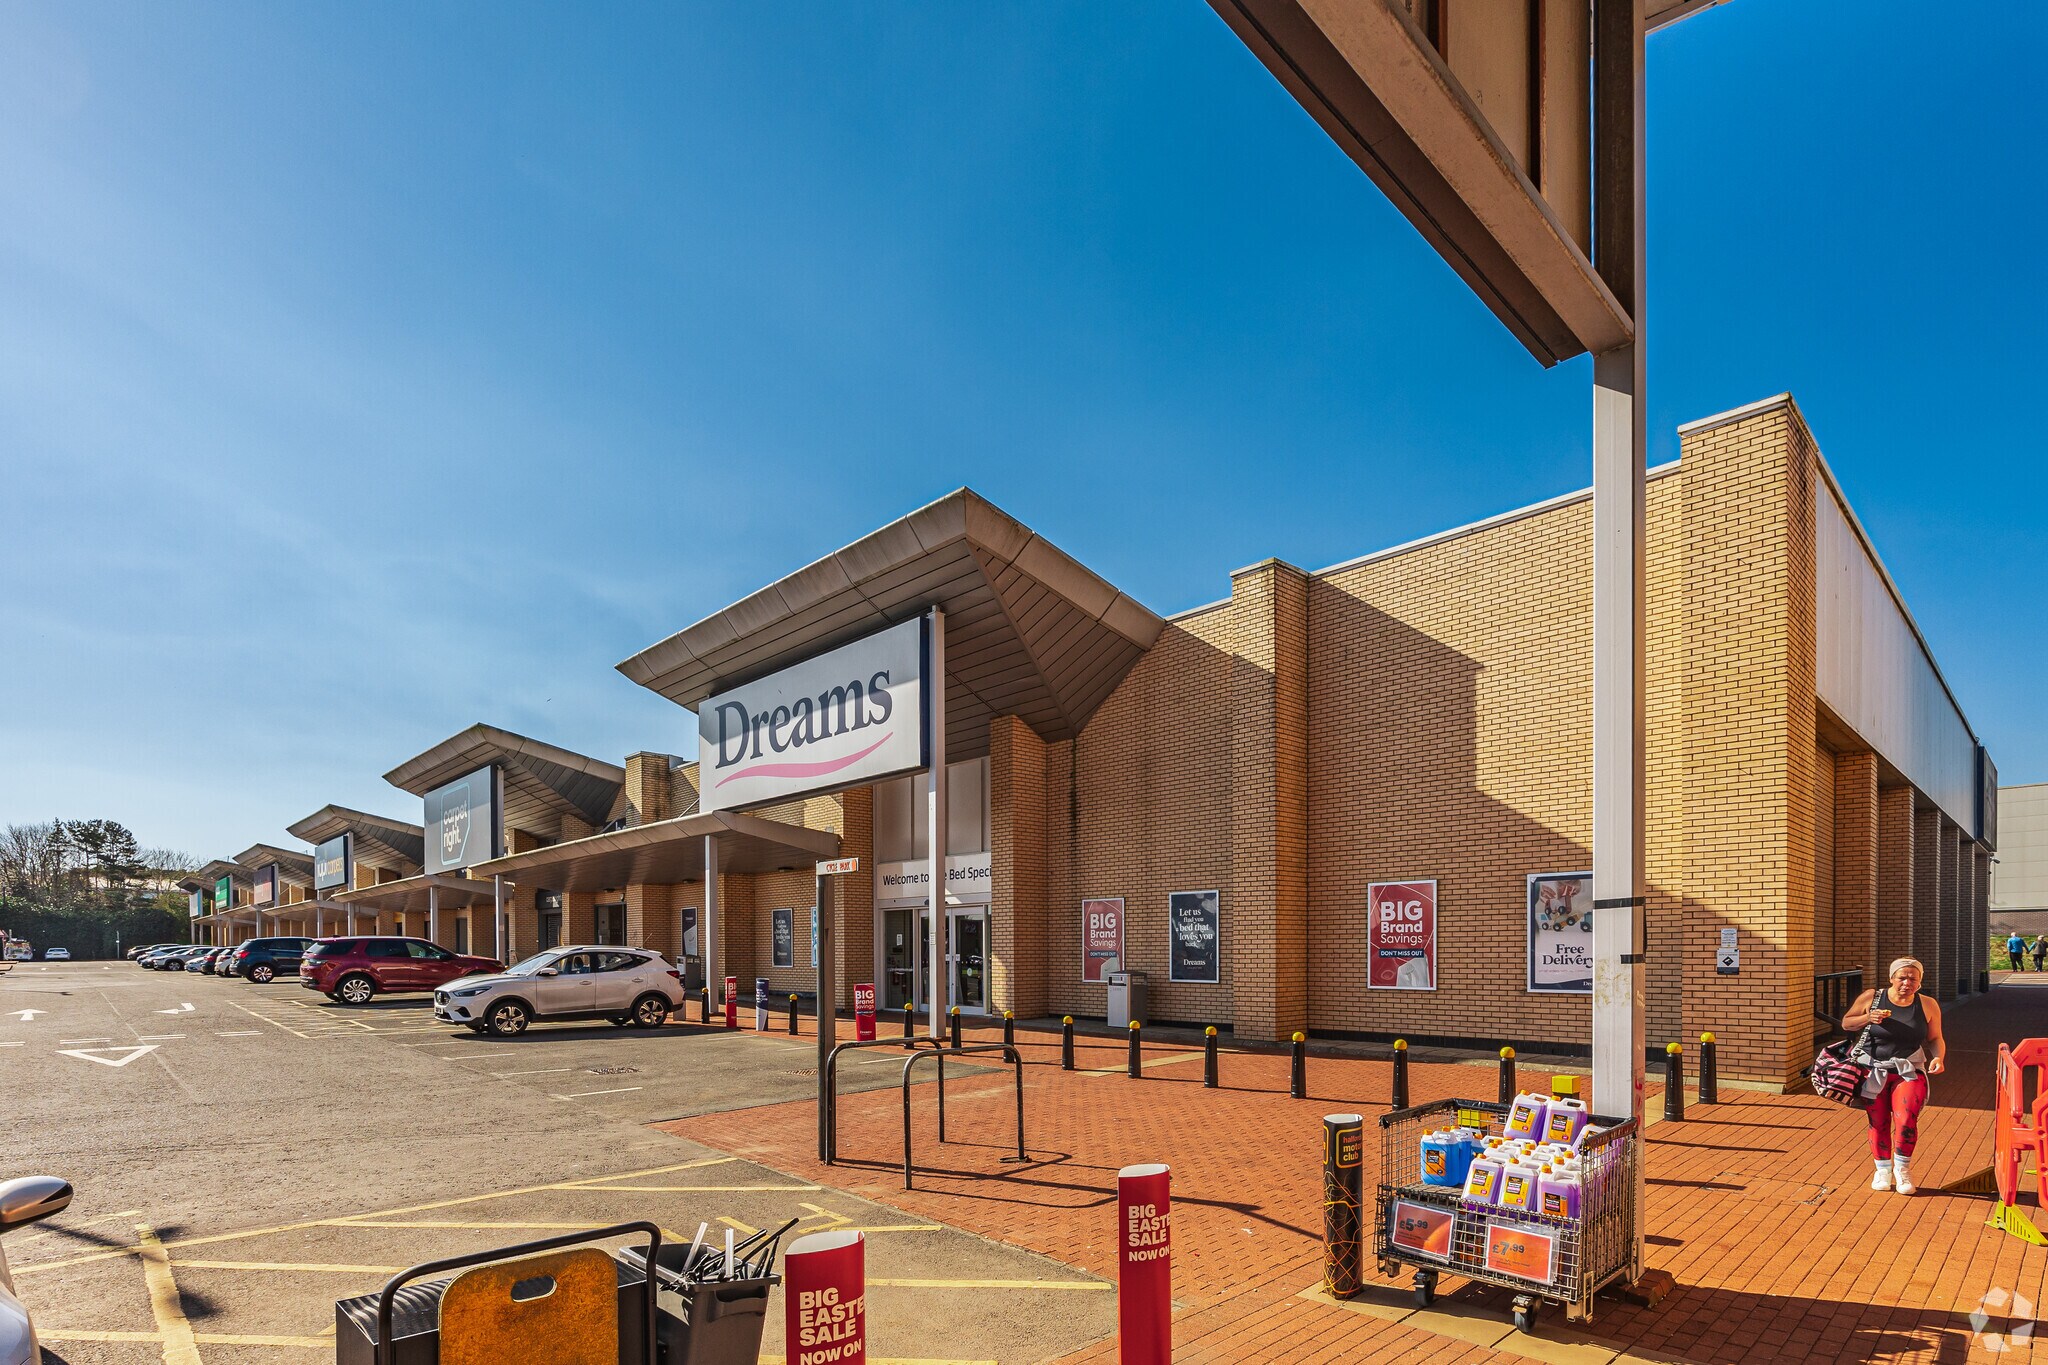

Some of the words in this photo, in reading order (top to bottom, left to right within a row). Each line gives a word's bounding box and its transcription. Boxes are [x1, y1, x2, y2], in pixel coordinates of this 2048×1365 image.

[715, 669, 893, 769] Dreams
[443, 800, 468, 827] carpet
[882, 874, 919, 886] Welcome
[921, 873, 930, 883] to
[950, 868, 966, 880] Bed
[1179, 908, 1191, 917] Let
[1380, 900, 1423, 921] BIG
[1090, 913, 1116, 929] BIG
[1380, 920, 1423, 933] Brand
[1090, 929, 1116, 938] Brand
[1179, 923, 1193, 932] bed
[1194, 923, 1209, 933] that
[1090, 939, 1117, 949] Savings
[1179, 932, 1198, 941] loves
[1198, 933, 1213, 943] you
[1380, 933, 1423, 946] Savings
[1555, 943, 1585, 954] Free
[855, 990, 874, 999] BIG
[1343, 1151, 1359, 1162] club
[1128, 1203, 1156, 1219] BIG
[1128, 1228, 1167, 1247] SALE
[1128, 1249, 1159, 1262] NOW
[1158, 1244, 1170, 1258] ON
[799, 1287, 839, 1310] BIG
[799, 1318, 857, 1347] SALE
[800, 1346, 842, 1365] NOW
[843, 1338, 862, 1358] ON
